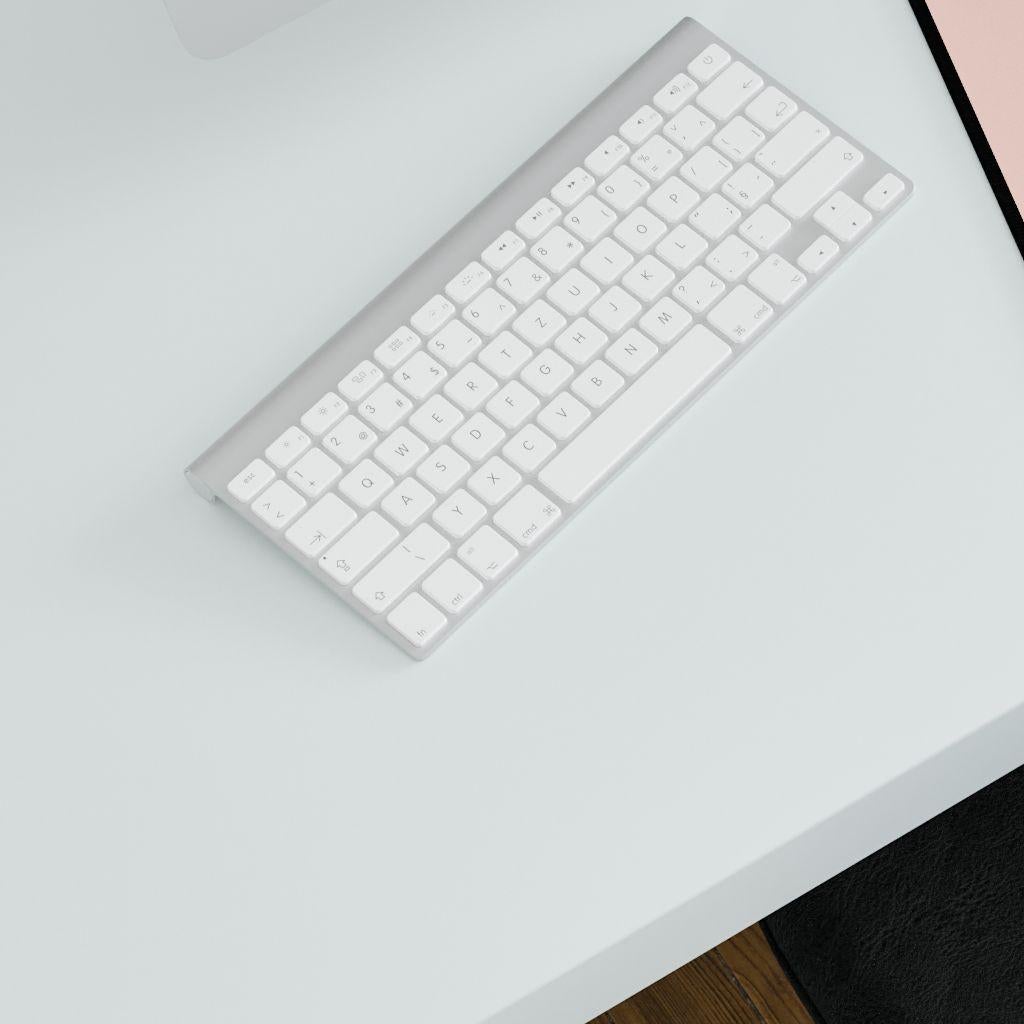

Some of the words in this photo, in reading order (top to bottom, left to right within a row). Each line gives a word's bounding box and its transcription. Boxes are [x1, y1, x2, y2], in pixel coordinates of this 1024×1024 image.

[293, 470, 304, 478] 1
[330, 436, 342, 447] 2
[365, 404, 376, 414] 3
[402, 372, 411, 381] 4
[435, 340, 446, 351] 5
[470, 309, 480, 319] 6
[502, 277, 512, 287] 7
[537, 247, 548, 256] 8
[571, 216, 580, 225] 9
[604, 185, 615, 194] 0
[361, 478, 375, 489] Q
[394, 443, 409, 457] W
[431, 413, 444, 424] E
[465, 381, 478, 391] R
[500, 348, 512, 358] T
[534, 316, 548, 329] Z
[567, 285, 581, 297] U
[636, 224, 648, 234] O
[668, 193, 678, 204] P
[401, 495, 414, 506] A
[435, 461, 447, 472] S
[469, 429, 482, 440] D
[504, 396, 515, 407] F
[539, 364, 551, 375] G
[572, 332, 586, 344] H
[608, 302, 618, 312] J
[640, 270, 653, 281] K
[674, 241, 686, 249] L
[451, 505, 463, 516] Y
[486, 472, 501, 486] X
[522, 440, 535, 451] C
[556, 407, 567, 418] V
[590, 376, 603, 387] B
[624, 343, 638, 356] N
[657, 311, 673, 325] M
[753, 304, 769, 320] cmd
[521, 523, 538, 539] cmd
